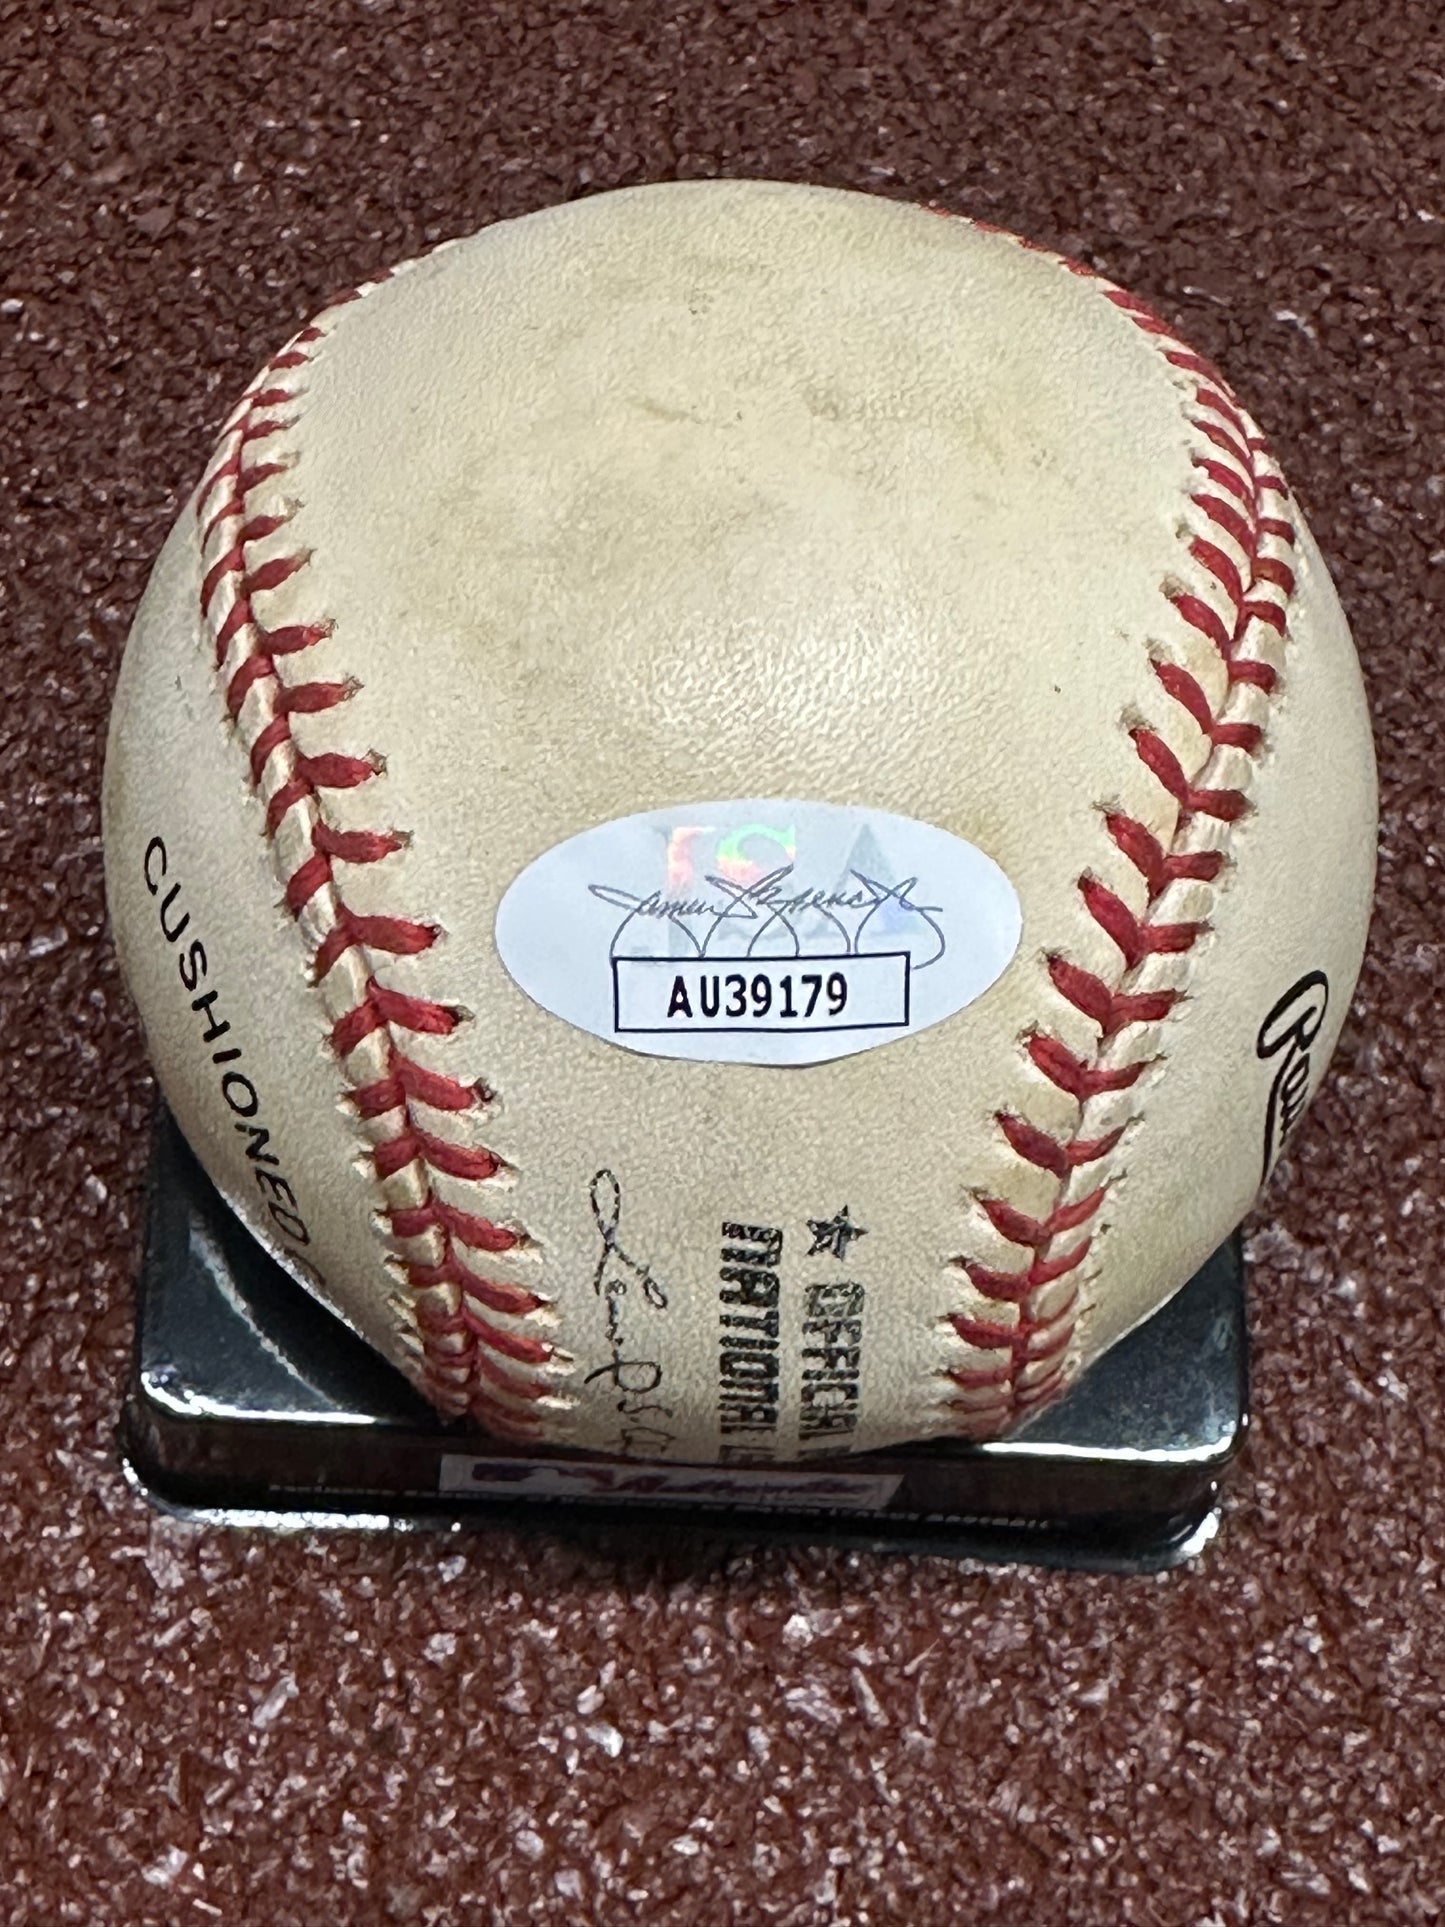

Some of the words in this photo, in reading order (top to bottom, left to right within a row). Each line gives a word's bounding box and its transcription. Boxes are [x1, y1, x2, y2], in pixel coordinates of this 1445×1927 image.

[143, 835, 312, 1248] CUSHIONED
[666, 972, 849, 1019] AU39179
[718, 1221, 784, 1435] NATIONAL
[798, 1280, 866, 1441] OFFICIAL
